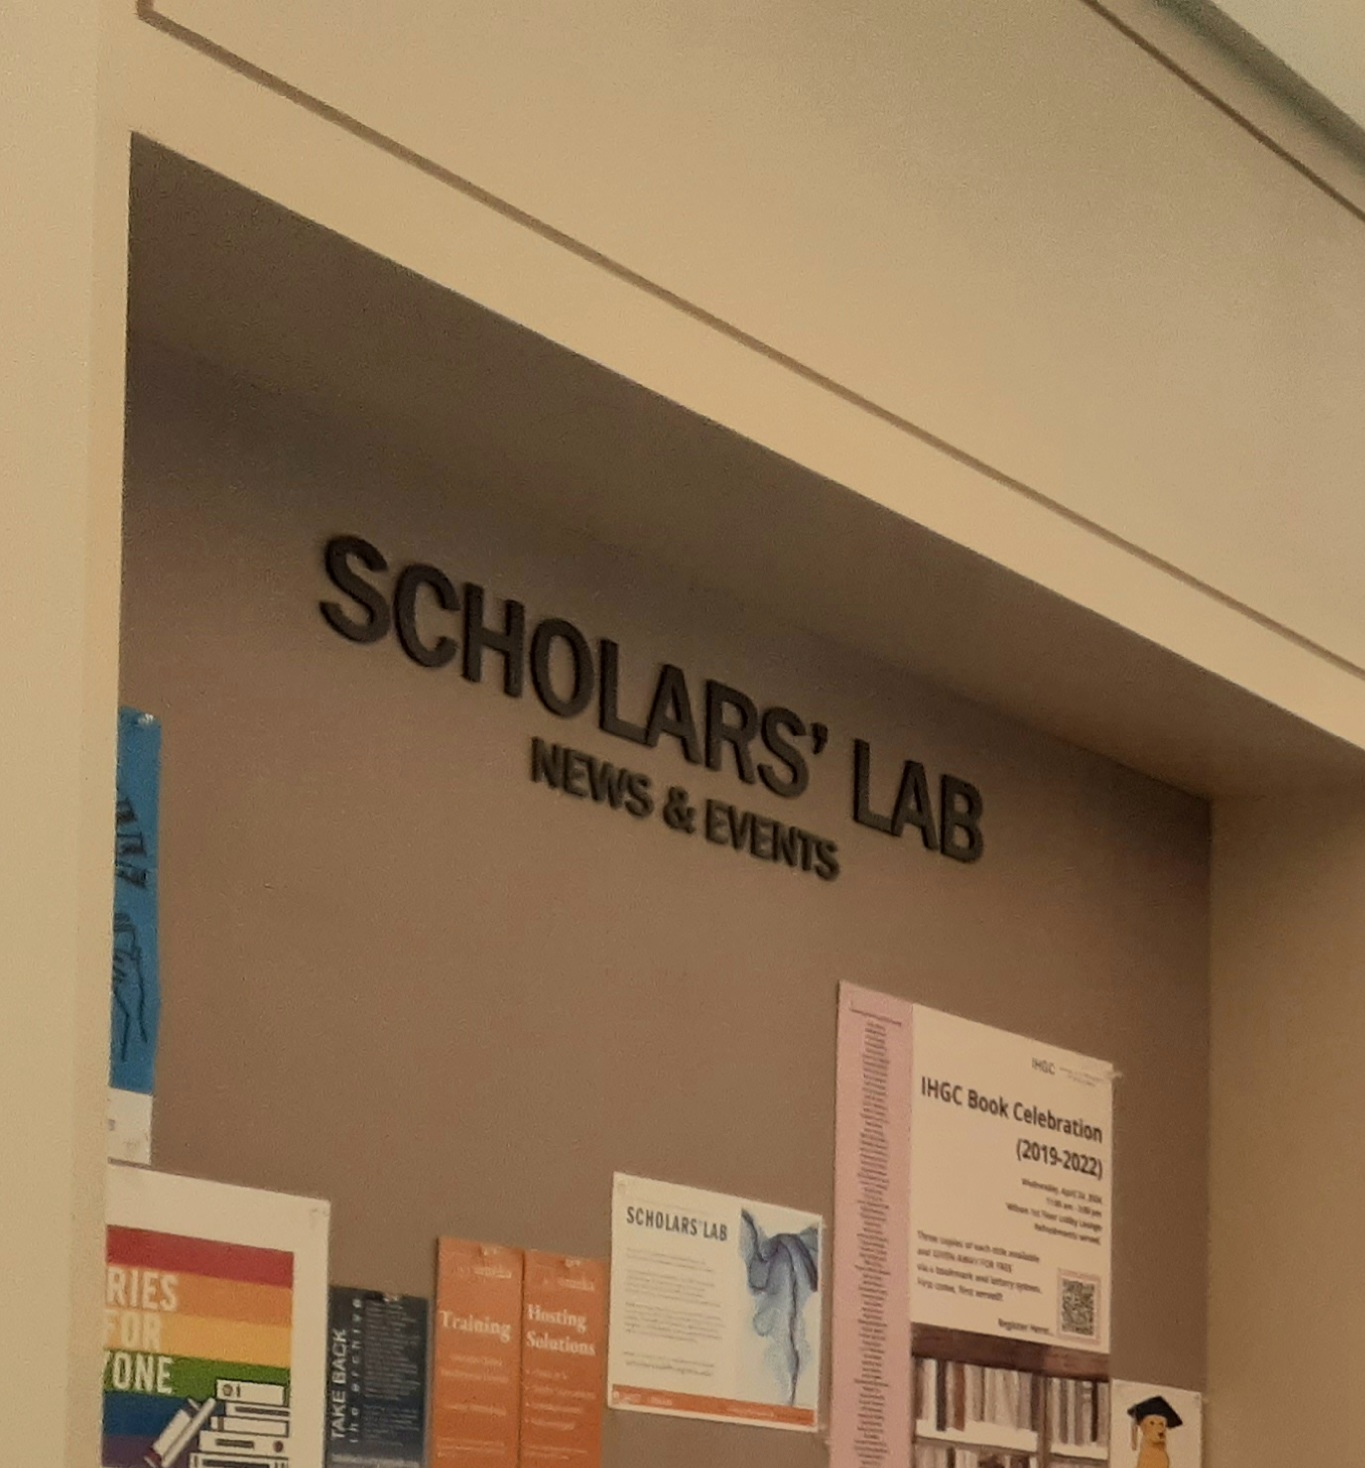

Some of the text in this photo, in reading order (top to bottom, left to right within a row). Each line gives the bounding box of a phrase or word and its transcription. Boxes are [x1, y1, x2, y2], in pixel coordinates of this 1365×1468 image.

[319, 532, 985, 864] SCHOLARS' LAB
[530, 736, 841, 881] NEWS & EVENTS
[921, 1076, 1103, 1143] IHGC Book Celebration
[1016, 1138, 1103, 1180] (2019-2022)
[703, 1221, 728, 1241] LAB
[440, 1310, 512, 1343] Training
[527, 1304, 587, 1332] Hosting
[526, 1331, 596, 1356] Solutions
[331, 1328, 348, 1440] TAKE BACK
